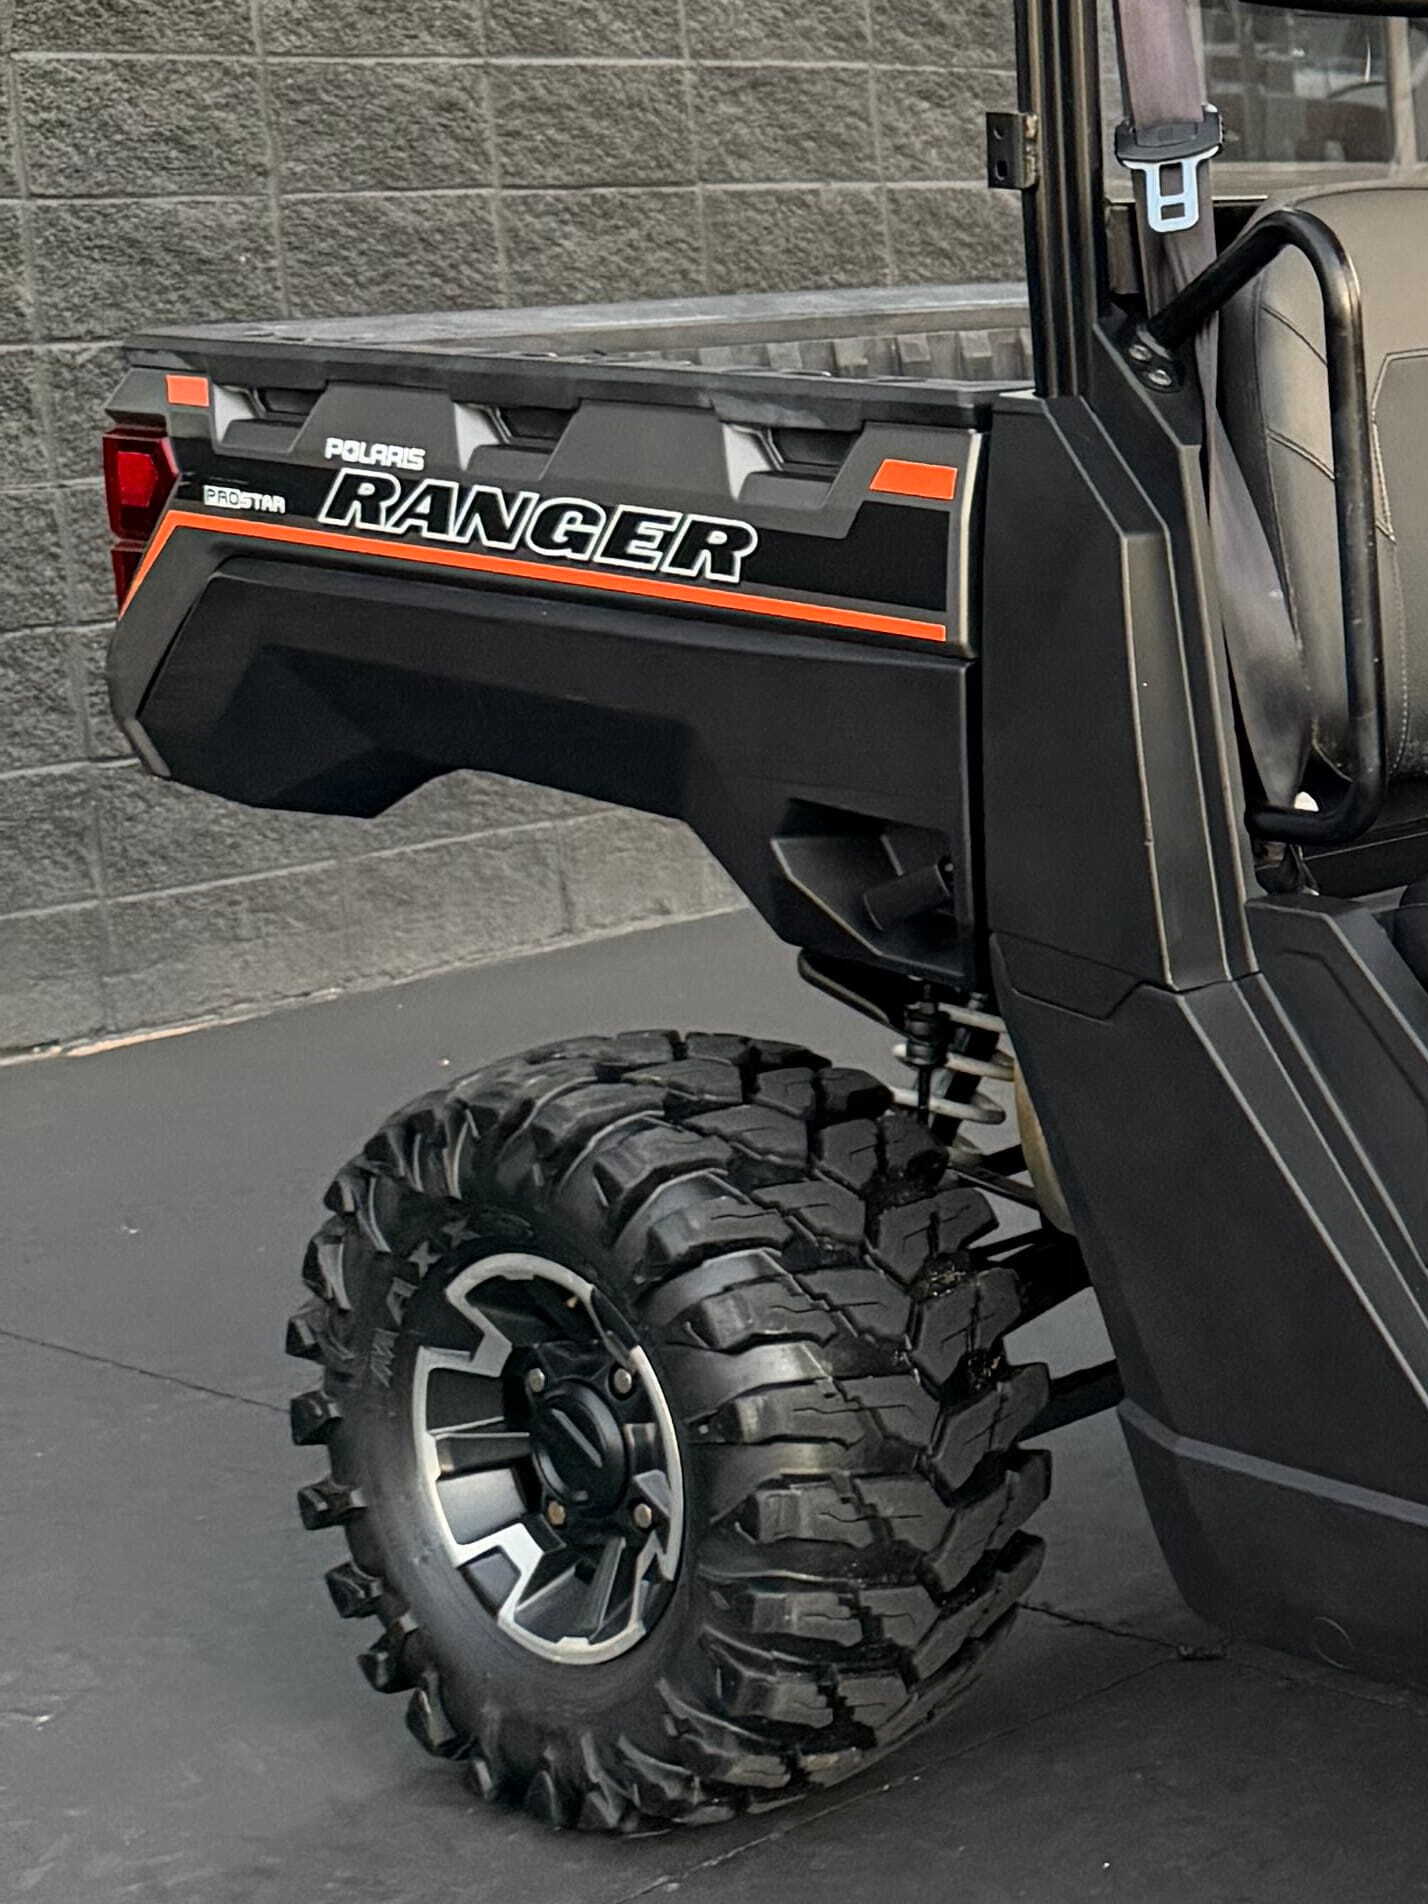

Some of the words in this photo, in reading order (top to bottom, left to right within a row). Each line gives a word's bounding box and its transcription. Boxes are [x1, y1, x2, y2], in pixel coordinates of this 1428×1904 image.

[323, 437, 427, 472] POLARIS
[203, 484, 287, 514] PROSTAR
[317, 466, 759, 585] RANGER
